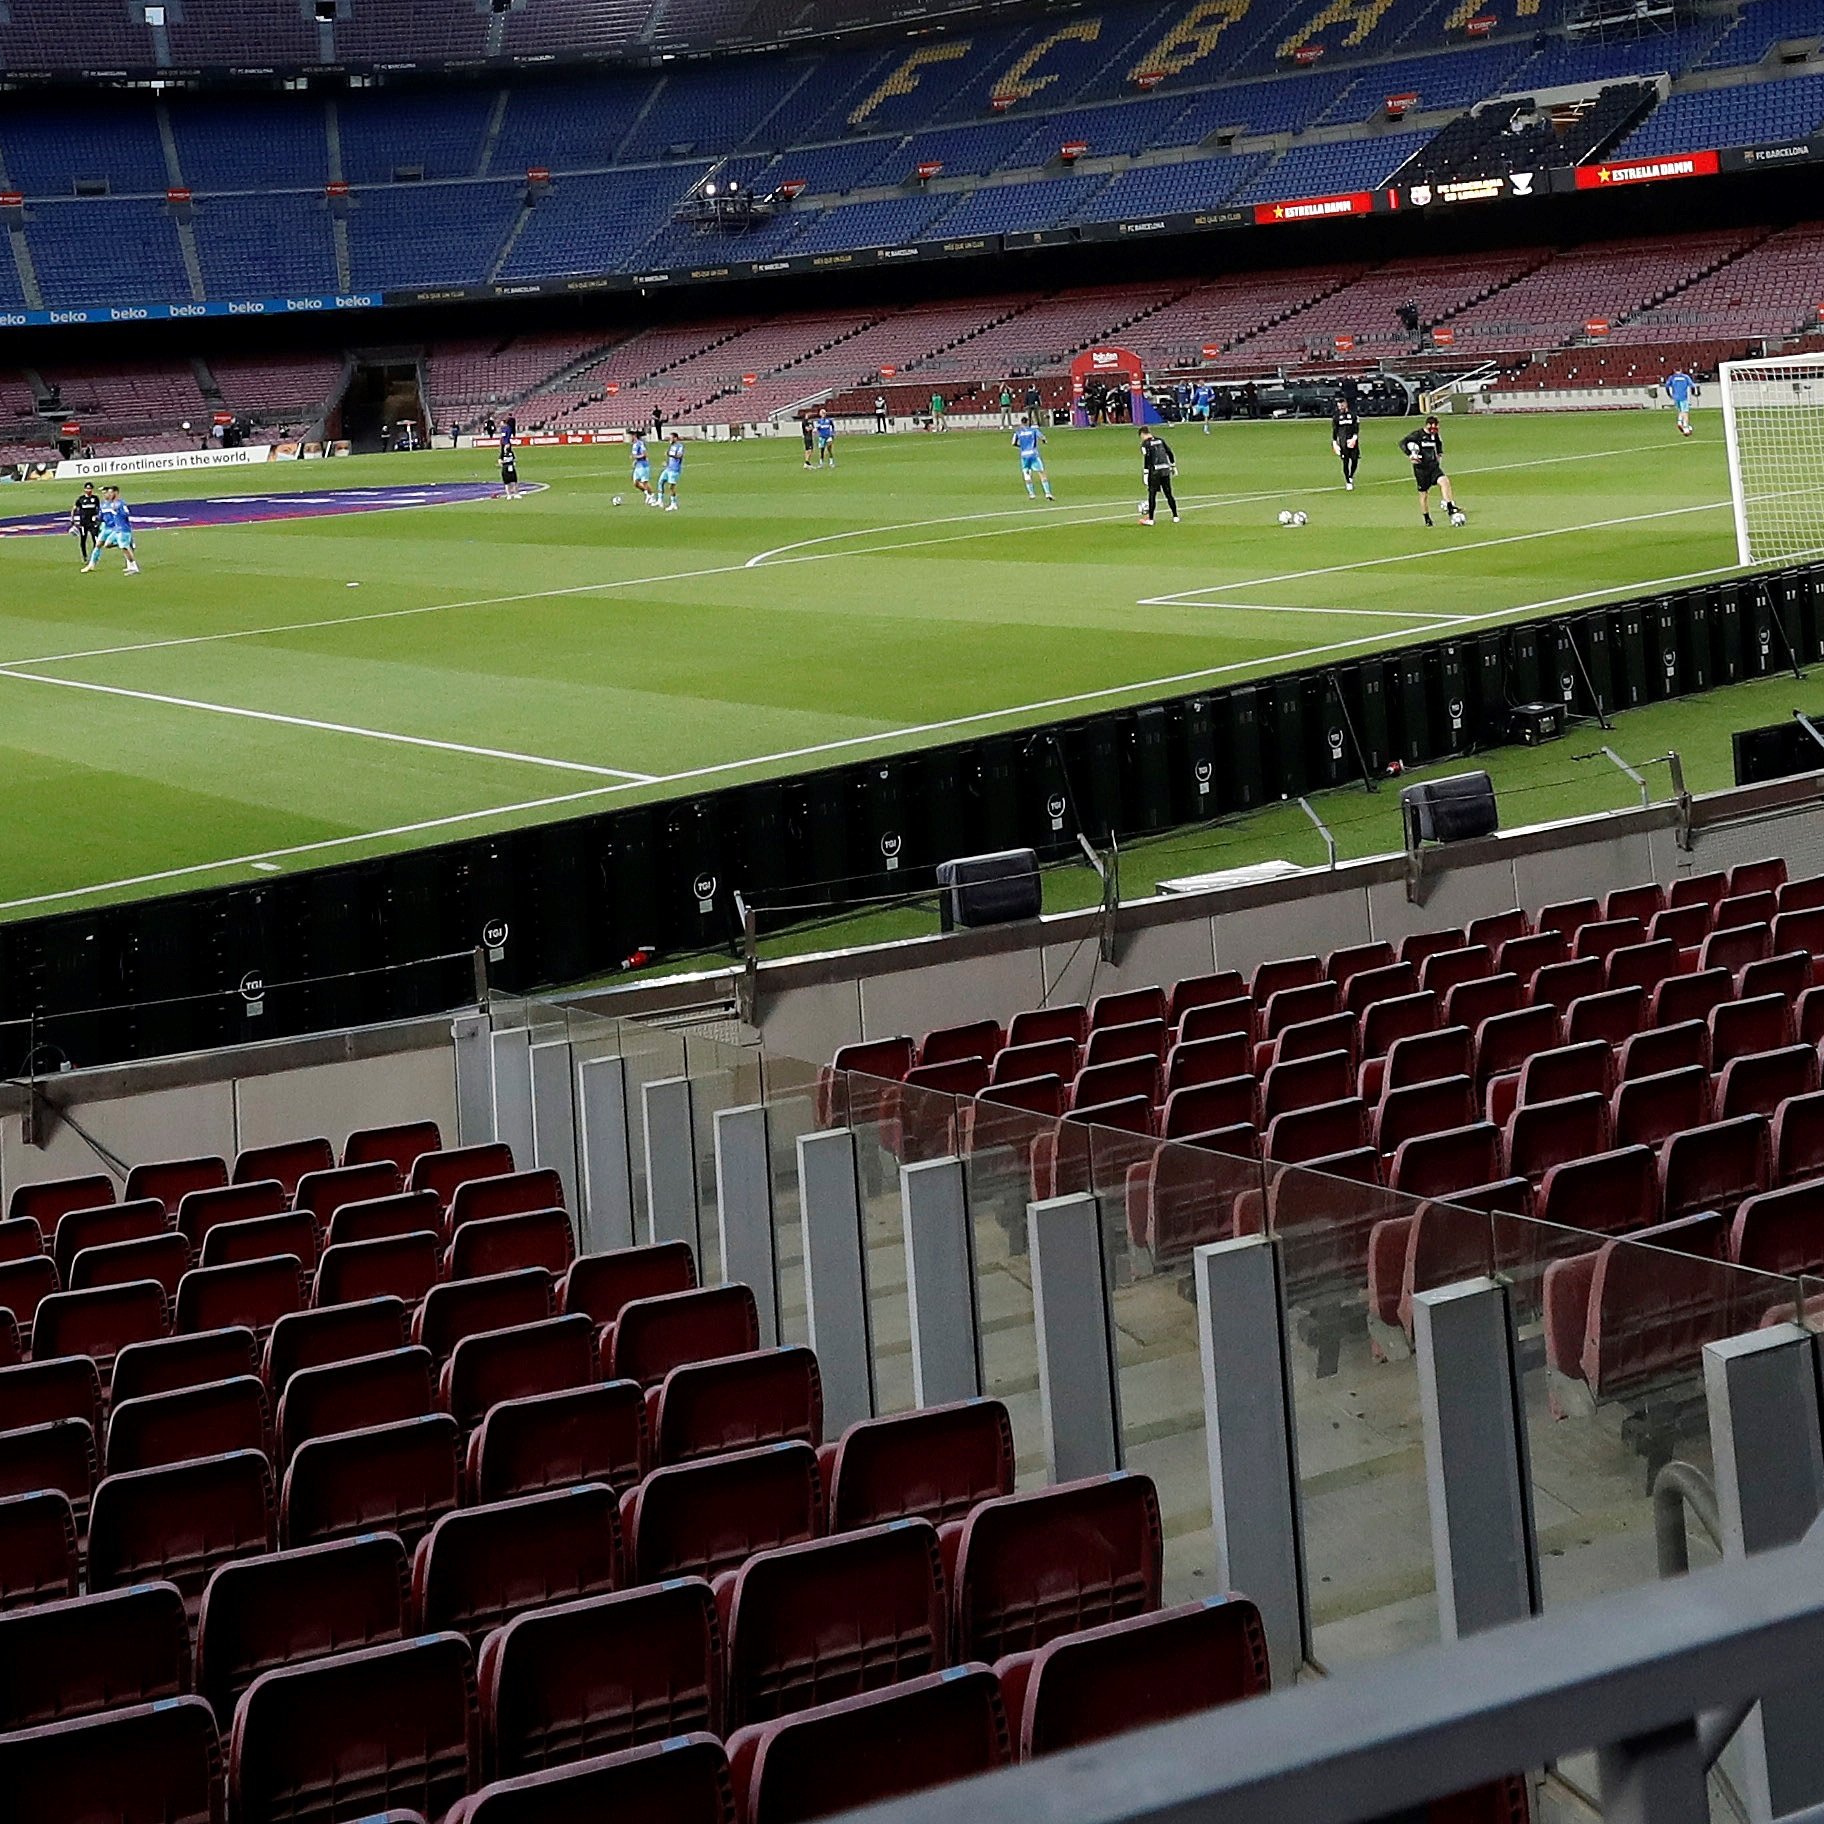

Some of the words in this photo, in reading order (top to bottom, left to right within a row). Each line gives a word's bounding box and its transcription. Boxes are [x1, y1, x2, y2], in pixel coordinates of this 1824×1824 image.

[1755, 149, 1768, 161] FC
[1768, 146, 1810, 160] BARCELONA
[1612, 163, 1660, 182] ESTRELLA
[1659, 161, 1694, 177] DAMM
[1284, 203, 1325, 218] ESTRELLA
[1324, 201, 1352, 214] DAMM
[228, 301, 264, 313] beko
[287, 298, 323, 310] beko
[335, 295, 371, 308] beko
[50, 311, 87, 323] beko
[111, 308, 148, 320] beko
[169, 304, 206, 317] beko
[76, 463, 91, 475] To
[93, 461, 108, 473] all
[110, 456, 174, 473] frontliners
[176, 455, 188, 466] in
[190, 453, 211, 466] the
[213, 450, 251, 464] world,
[697, 880, 712, 893] TGI
[487, 927, 503, 940] TGI
